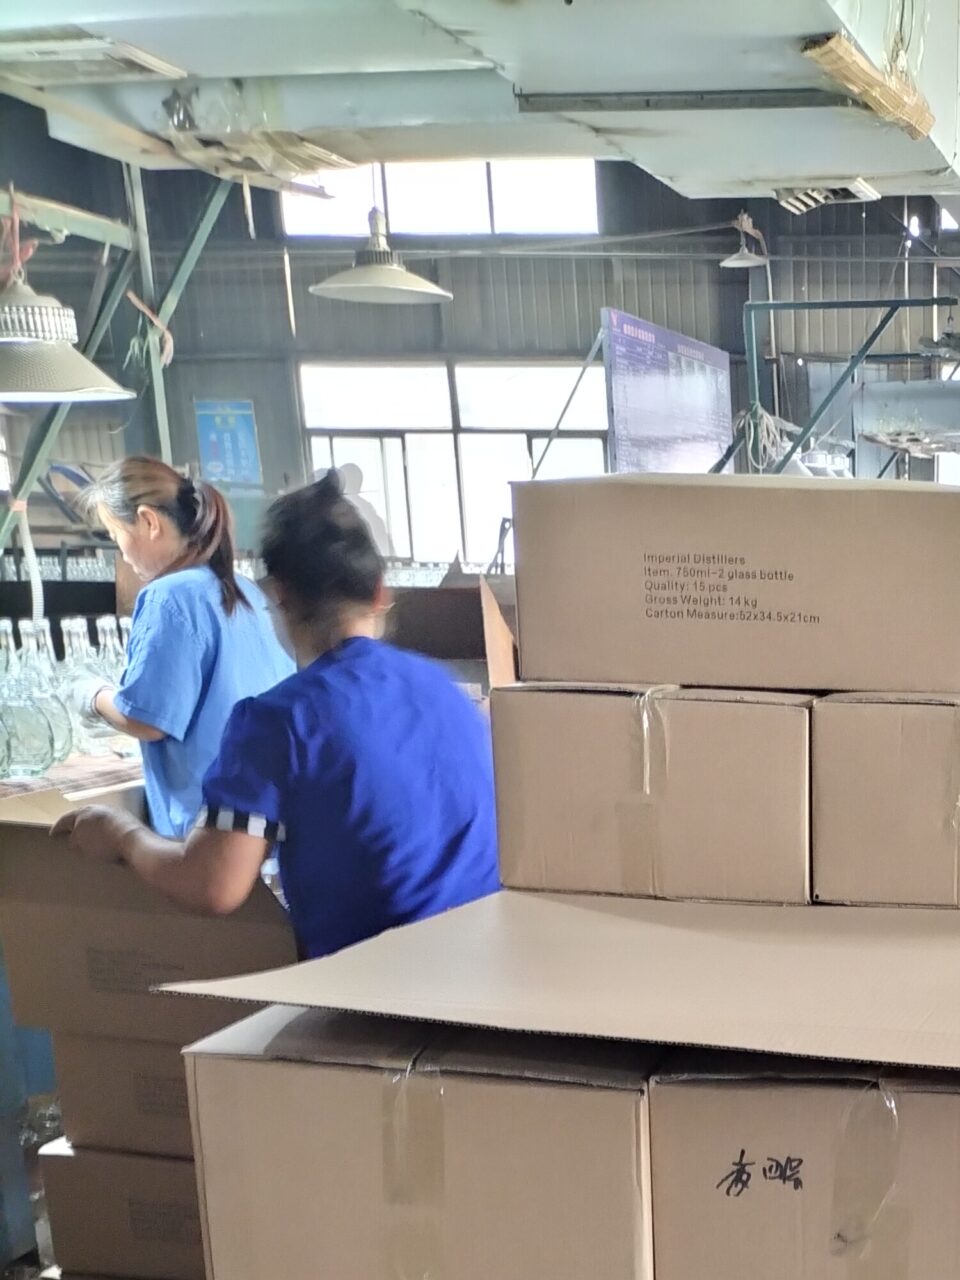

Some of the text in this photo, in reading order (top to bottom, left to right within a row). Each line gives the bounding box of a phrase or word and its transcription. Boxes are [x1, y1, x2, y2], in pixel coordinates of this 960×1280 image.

[643, 553, 745, 565] Imperial Distillers
[728, 570, 757, 581] glass
[760, 570, 794, 581] bottle
[645, 581, 727, 593] Quality: 15 pcs
[645, 595, 757, 608] Gross Weight: 14 kg
[646, 608, 683, 619] Carton
